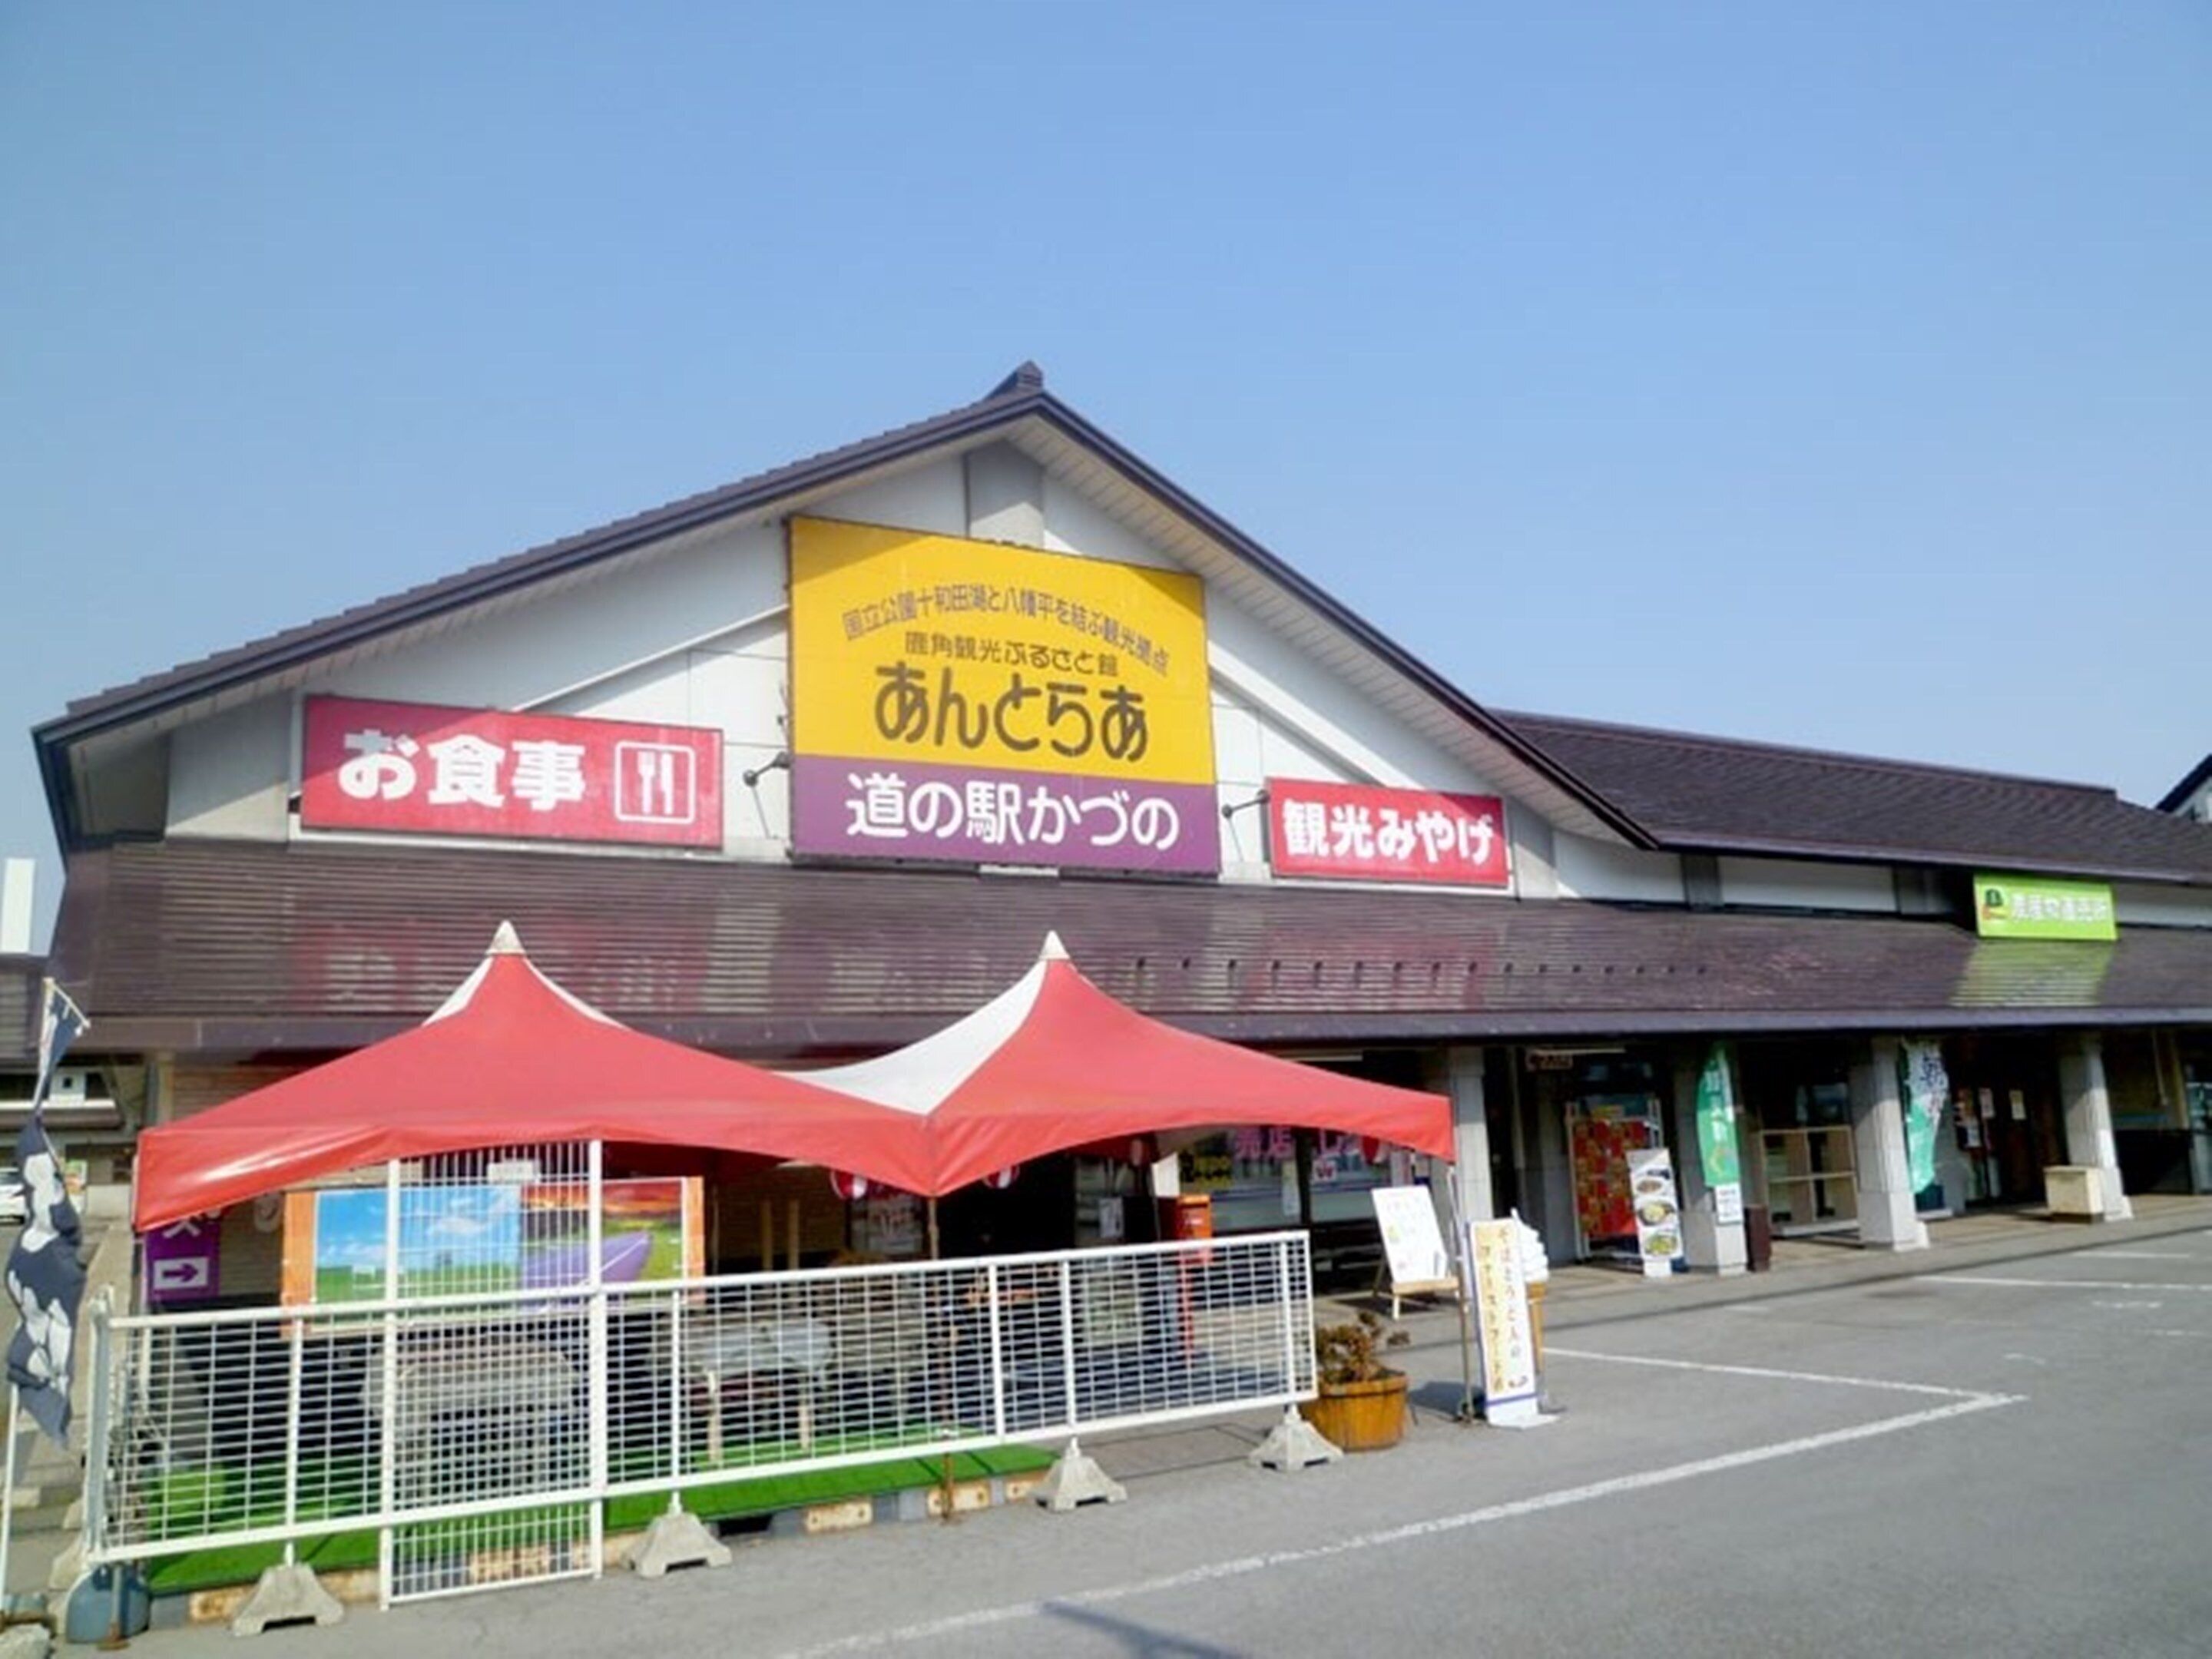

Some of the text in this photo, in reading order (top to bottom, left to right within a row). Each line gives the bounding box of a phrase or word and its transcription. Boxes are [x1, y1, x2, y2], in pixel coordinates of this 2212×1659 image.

[874, 661, 1148, 763] あんとらあ
[338, 728, 586, 811] お食事
[846, 773, 1180, 850] 道の駅かづの
[1283, 799, 1494, 866] 観光みやげ
